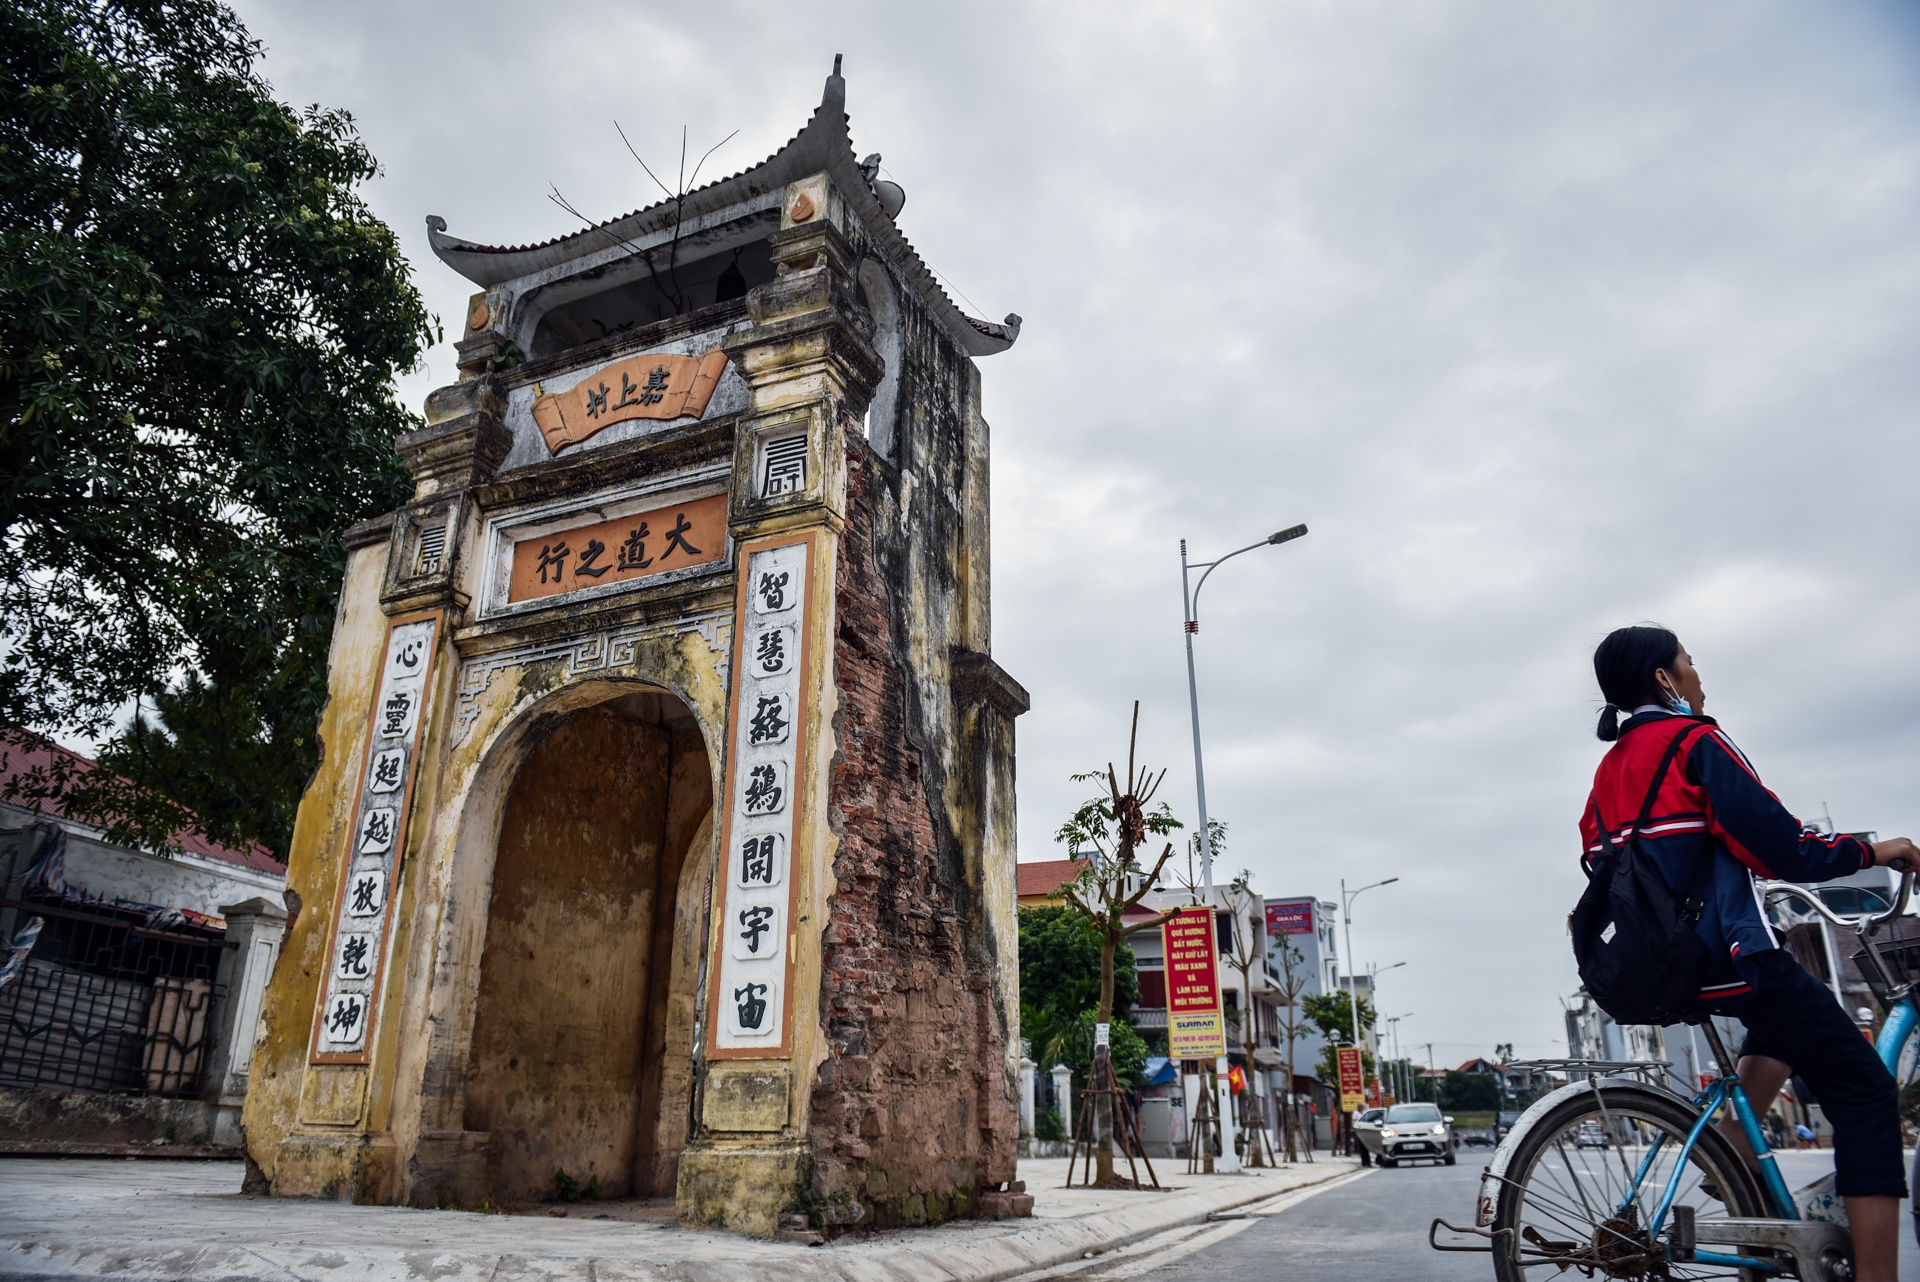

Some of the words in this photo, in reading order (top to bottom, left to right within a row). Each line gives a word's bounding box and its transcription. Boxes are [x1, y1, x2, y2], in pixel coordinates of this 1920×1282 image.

[535, 512, 702, 584] 大道之行
[1197, 916, 1207, 924] LAI
[1190, 961, 1207, 970] XANH
